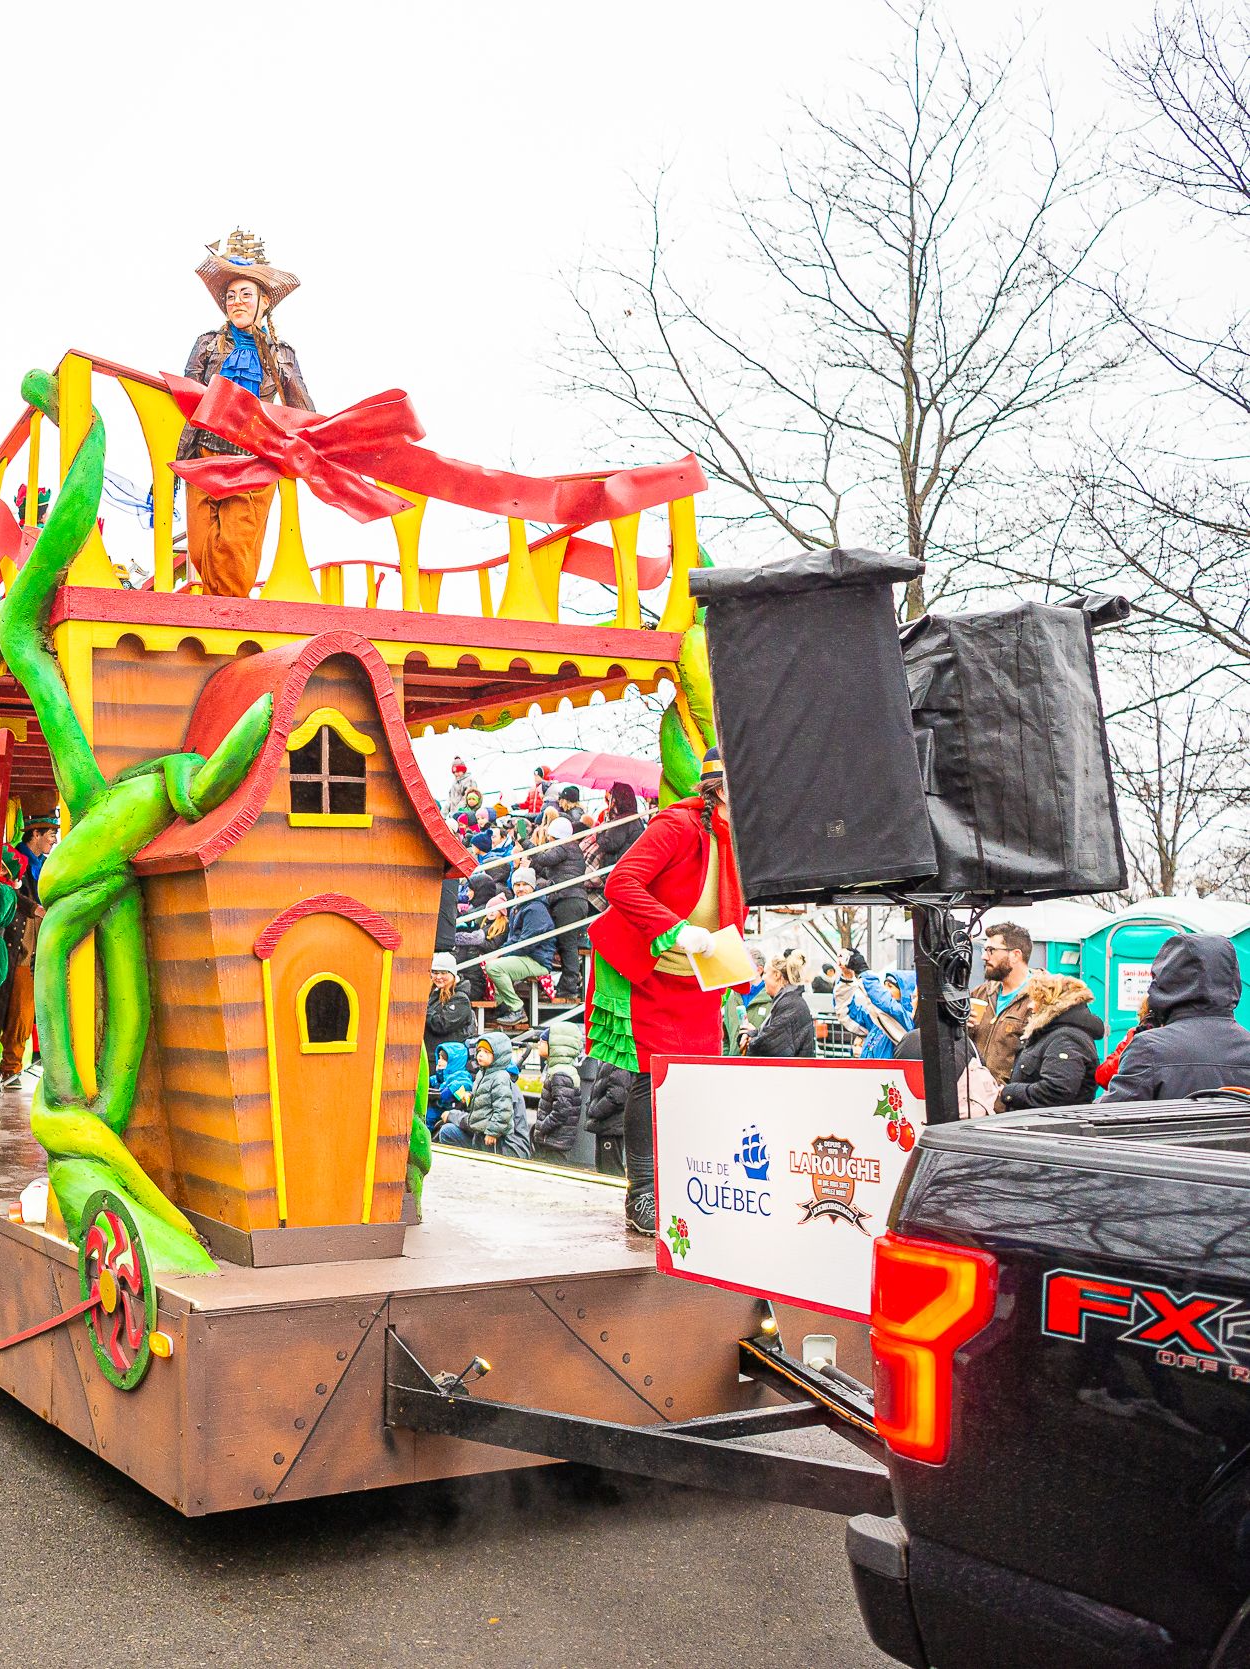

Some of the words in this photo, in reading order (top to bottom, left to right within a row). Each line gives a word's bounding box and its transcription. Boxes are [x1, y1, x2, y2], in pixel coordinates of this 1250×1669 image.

[686, 1156, 712, 1174] VILLE
[717, 1163, 730, 1176] DE
[789, 1150, 881, 1184] LAROUCHE
[687, 1176, 772, 1217] QUÉBEC
[1041, 1267, 1250, 1364] FX
[1156, 1350, 1219, 1373] OFF
